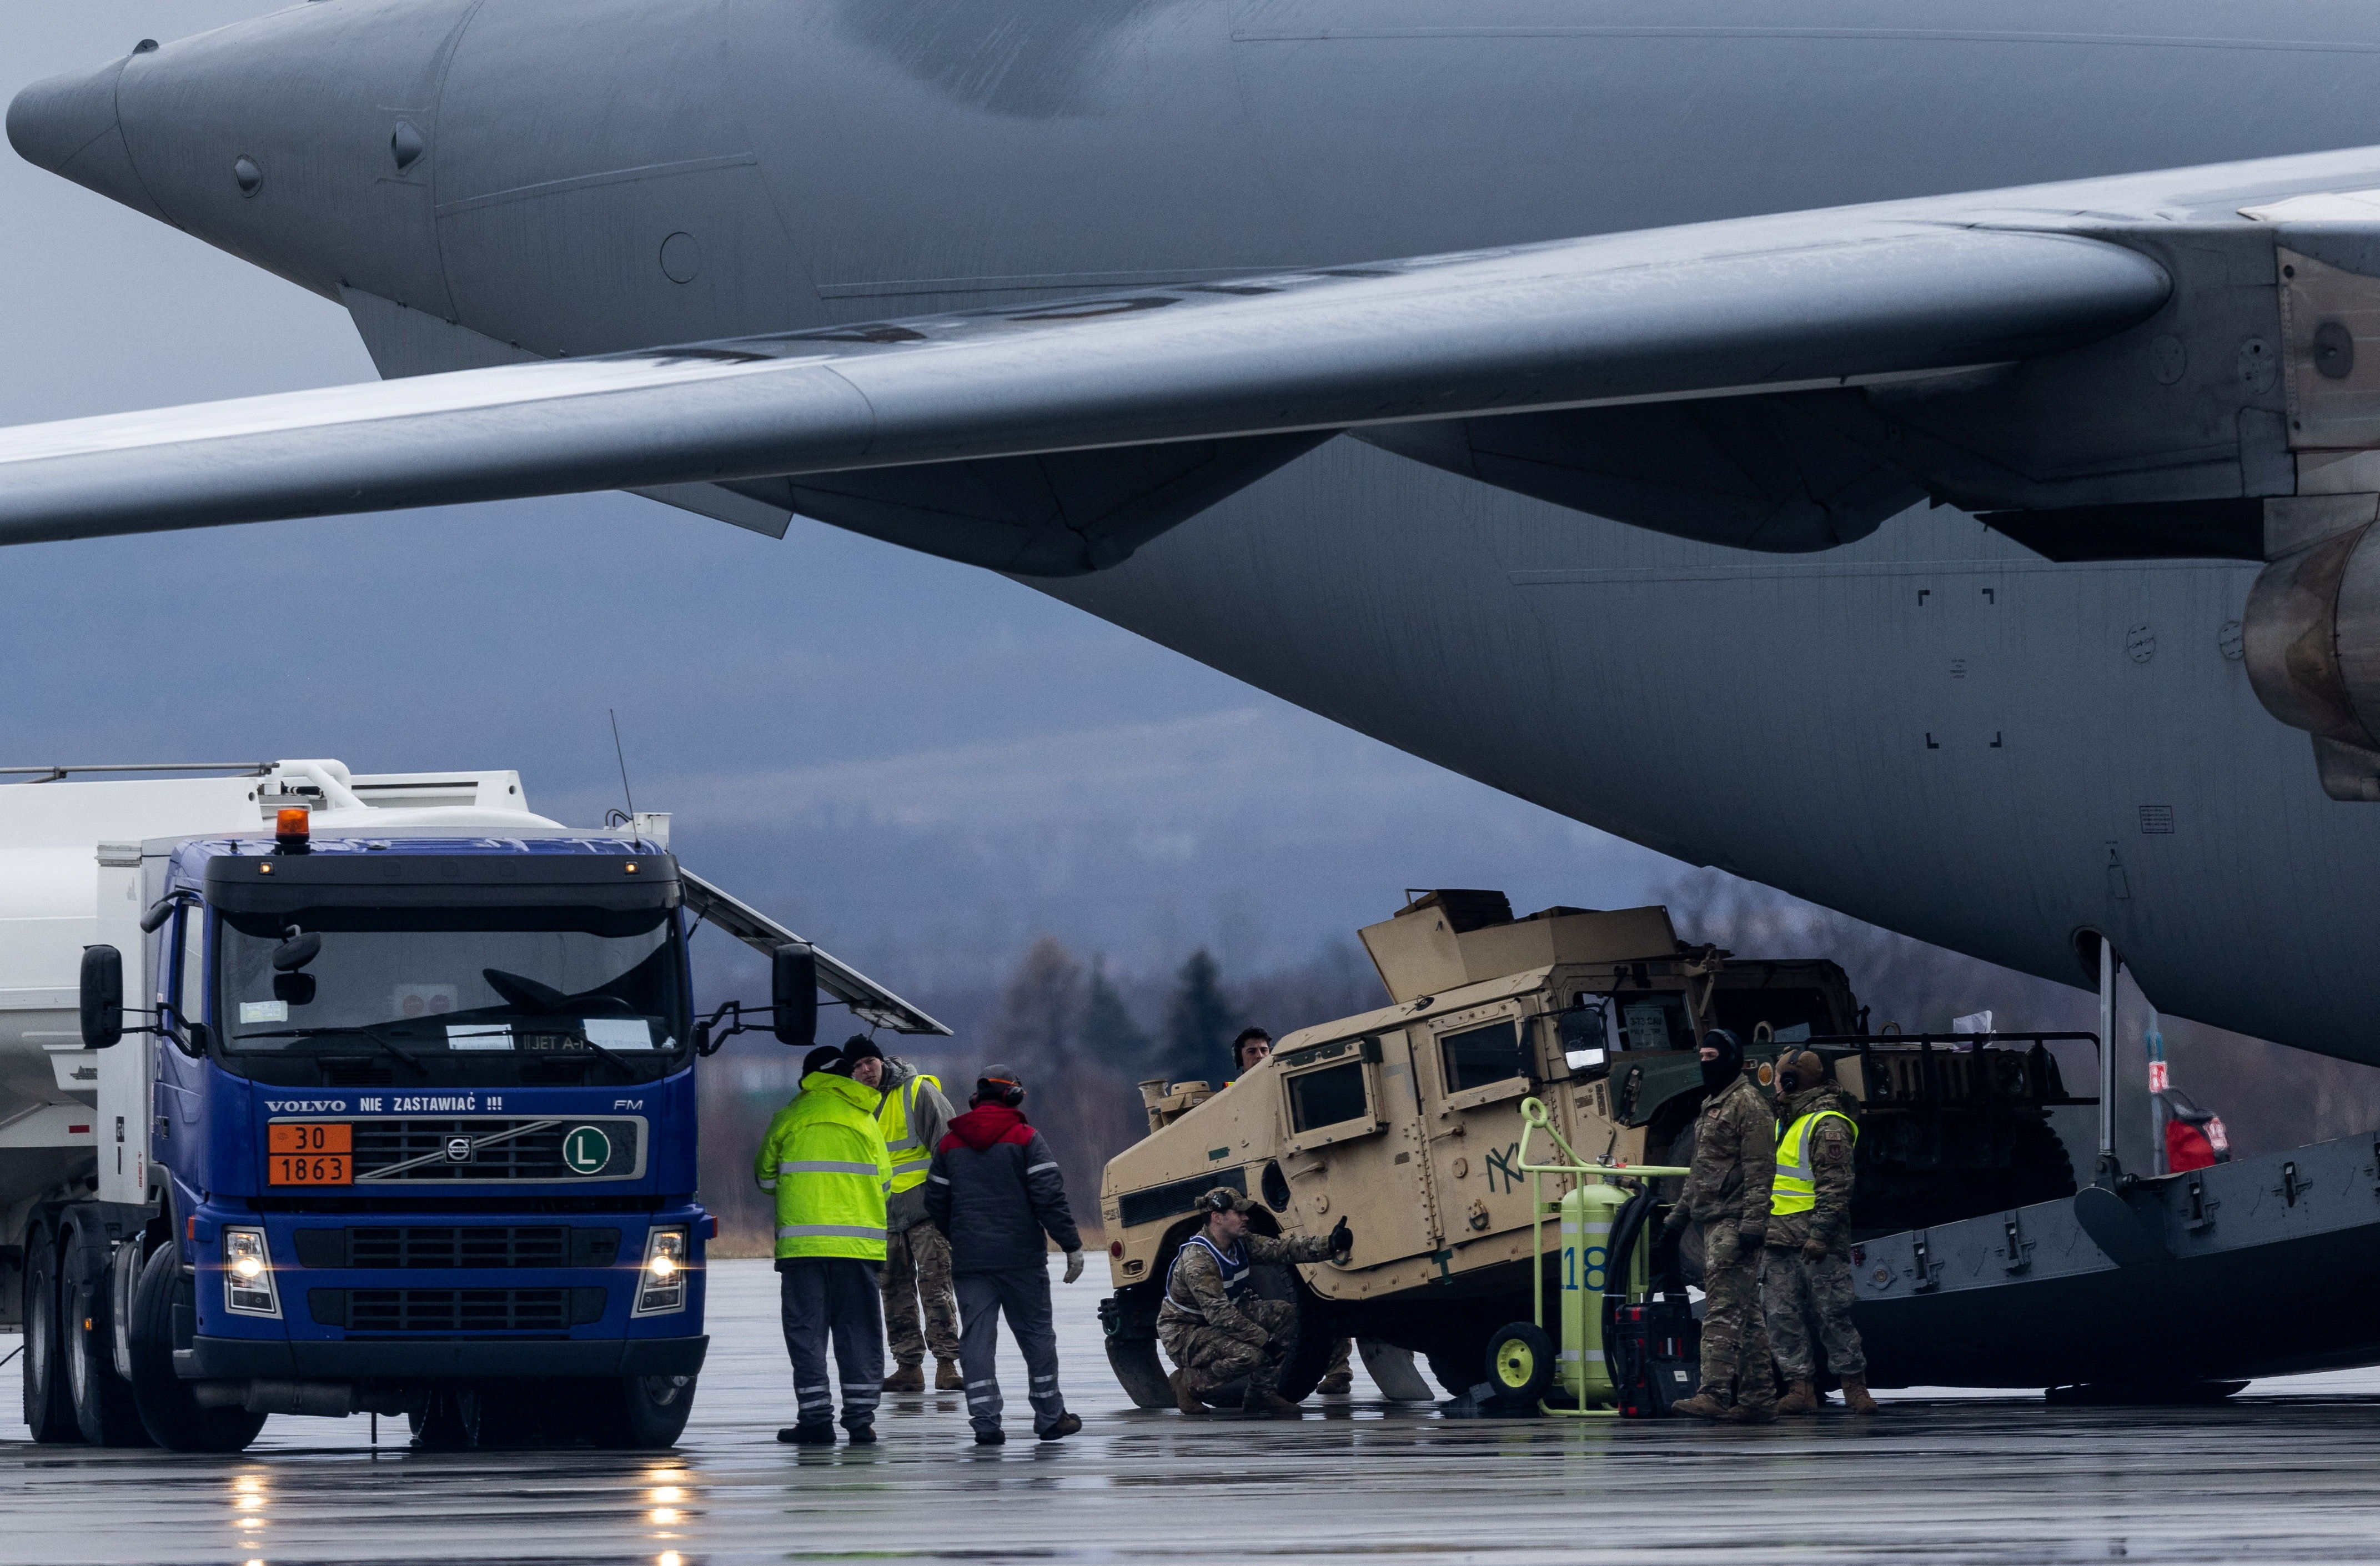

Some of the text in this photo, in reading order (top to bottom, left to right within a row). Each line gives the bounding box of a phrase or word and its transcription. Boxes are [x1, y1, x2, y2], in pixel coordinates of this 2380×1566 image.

[531, 1036, 556, 1050] JET
[264, 1100, 347, 1112] VOLVO
[360, 1097, 382, 1111] NIE
[487, 1096, 502, 1111] !!!
[614, 1100, 643, 1110] FM
[295, 1126, 325, 1150] 30
[578, 1136, 596, 1164] L
[281, 1157, 343, 1181] 1863
[1561, 1246, 1606, 1291] 18
